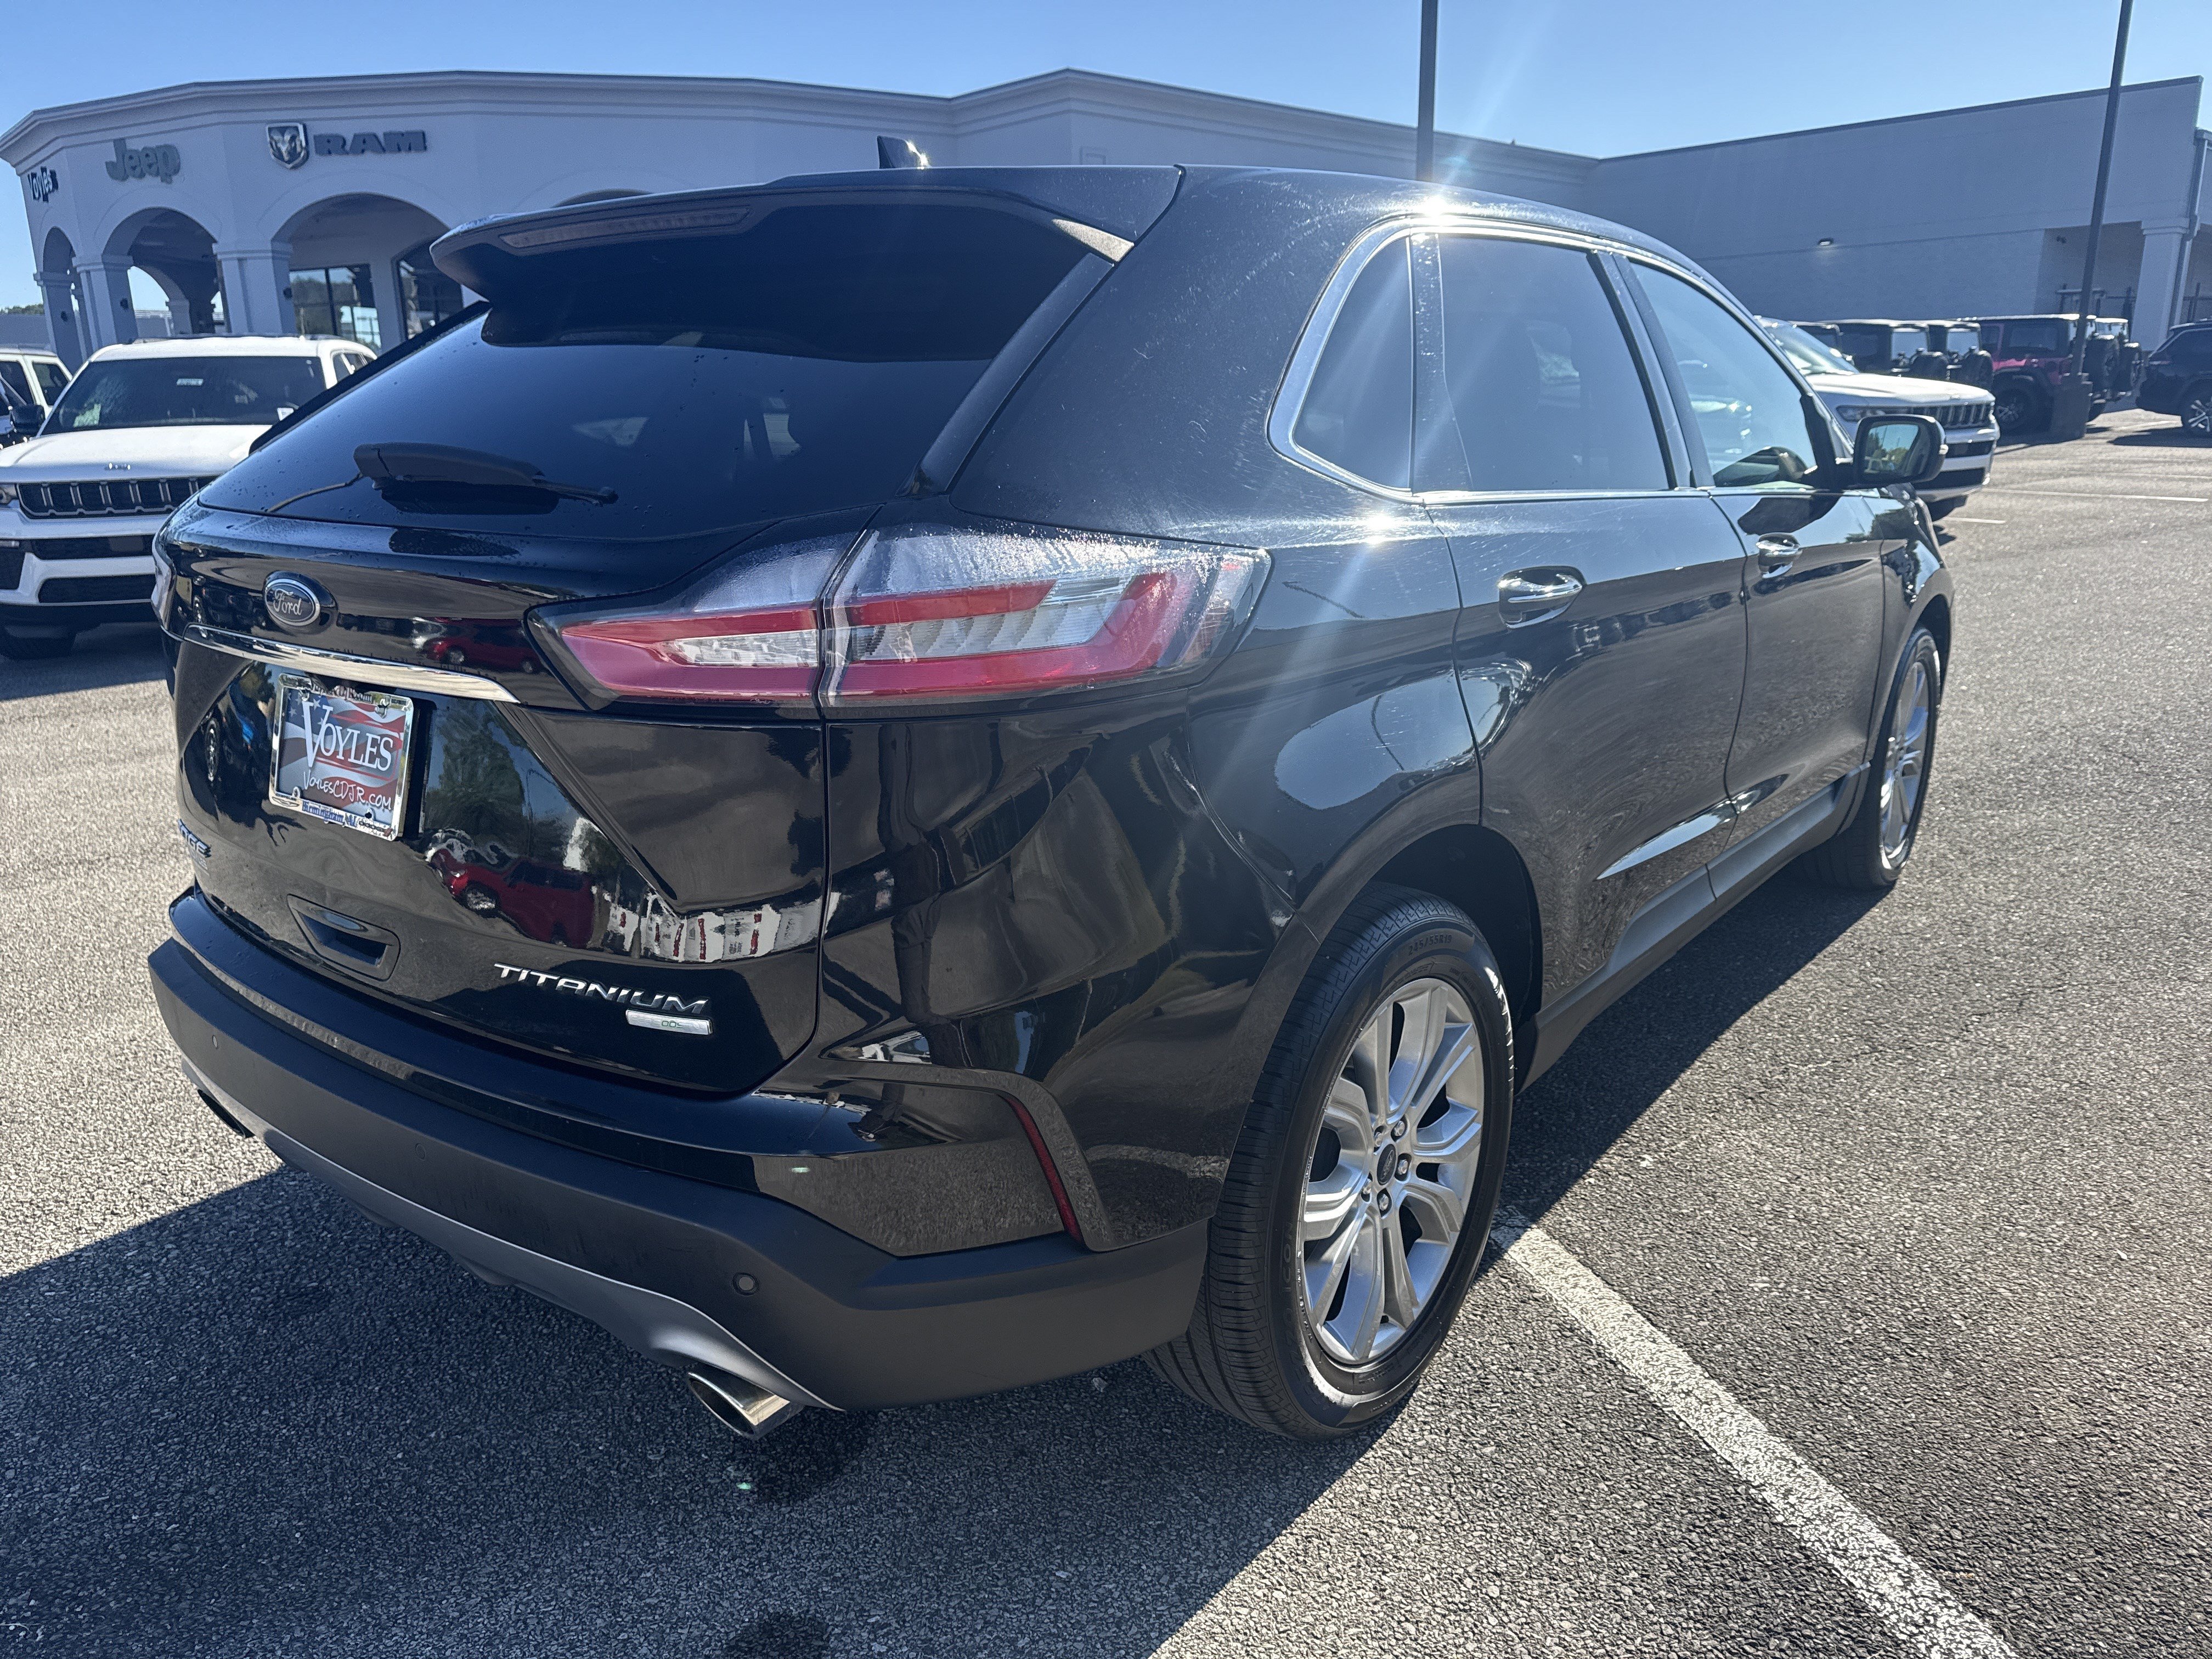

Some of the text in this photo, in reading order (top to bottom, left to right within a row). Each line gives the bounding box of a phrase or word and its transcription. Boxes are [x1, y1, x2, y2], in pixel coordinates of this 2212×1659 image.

[105, 138, 181, 184] Jeep
[313, 131, 427, 156] RAM
[273, 588, 302, 616] Ford
[494, 963, 709, 1014] TITANIUM
